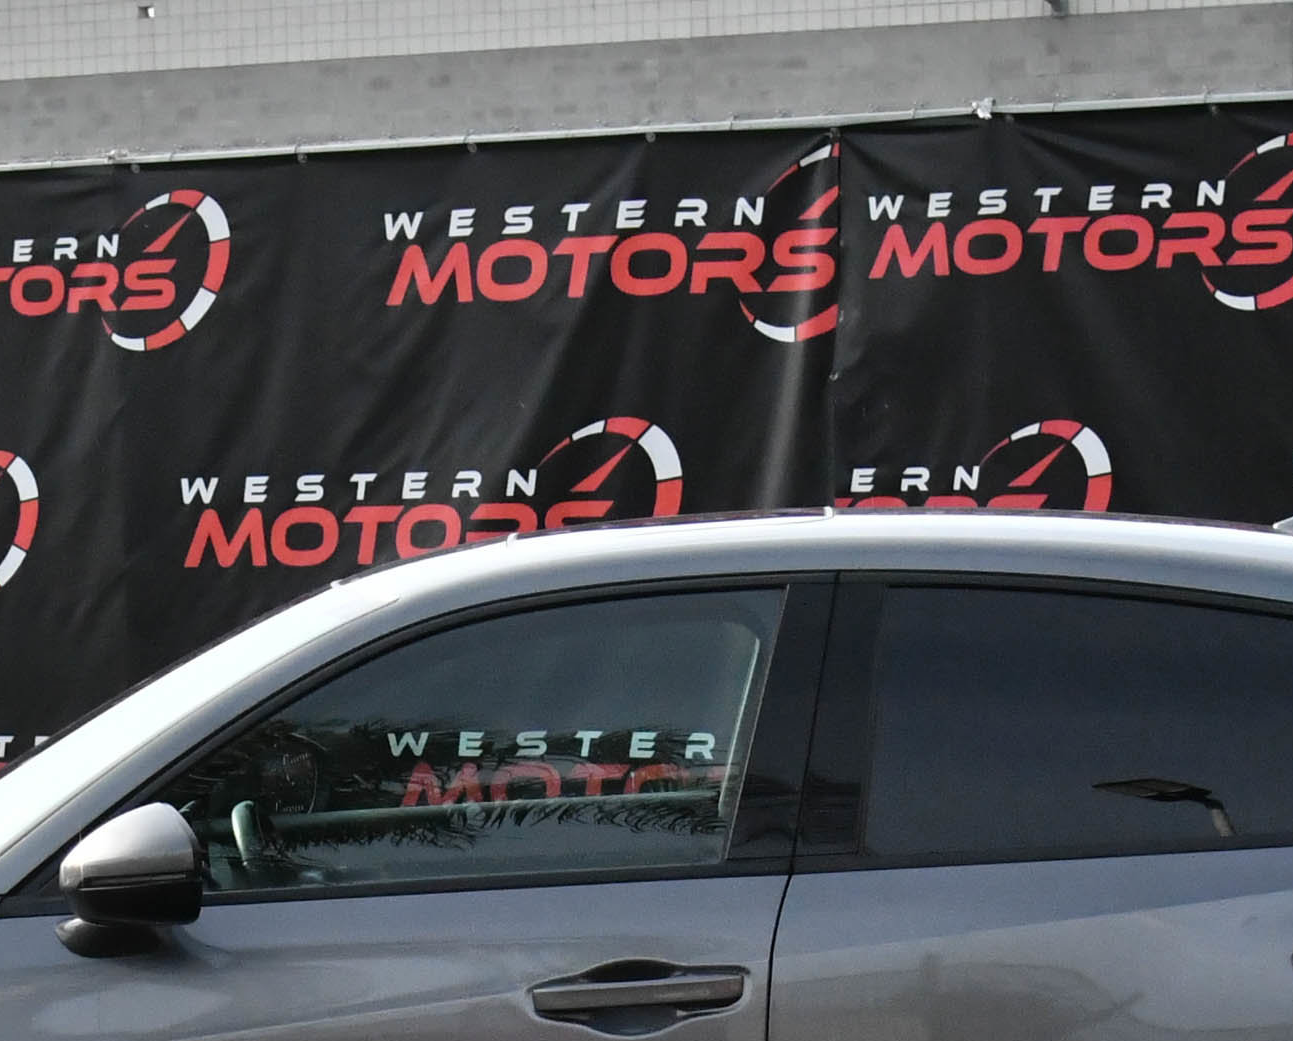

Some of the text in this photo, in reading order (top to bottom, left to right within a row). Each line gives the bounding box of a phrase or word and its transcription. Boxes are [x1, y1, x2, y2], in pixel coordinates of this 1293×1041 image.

[384, 196, 765, 241] WESTERN
[868, 179, 1226, 221] WESTERN
[387, 227, 837, 307] MOTORS
[180, 469, 537, 505] WESTERN
